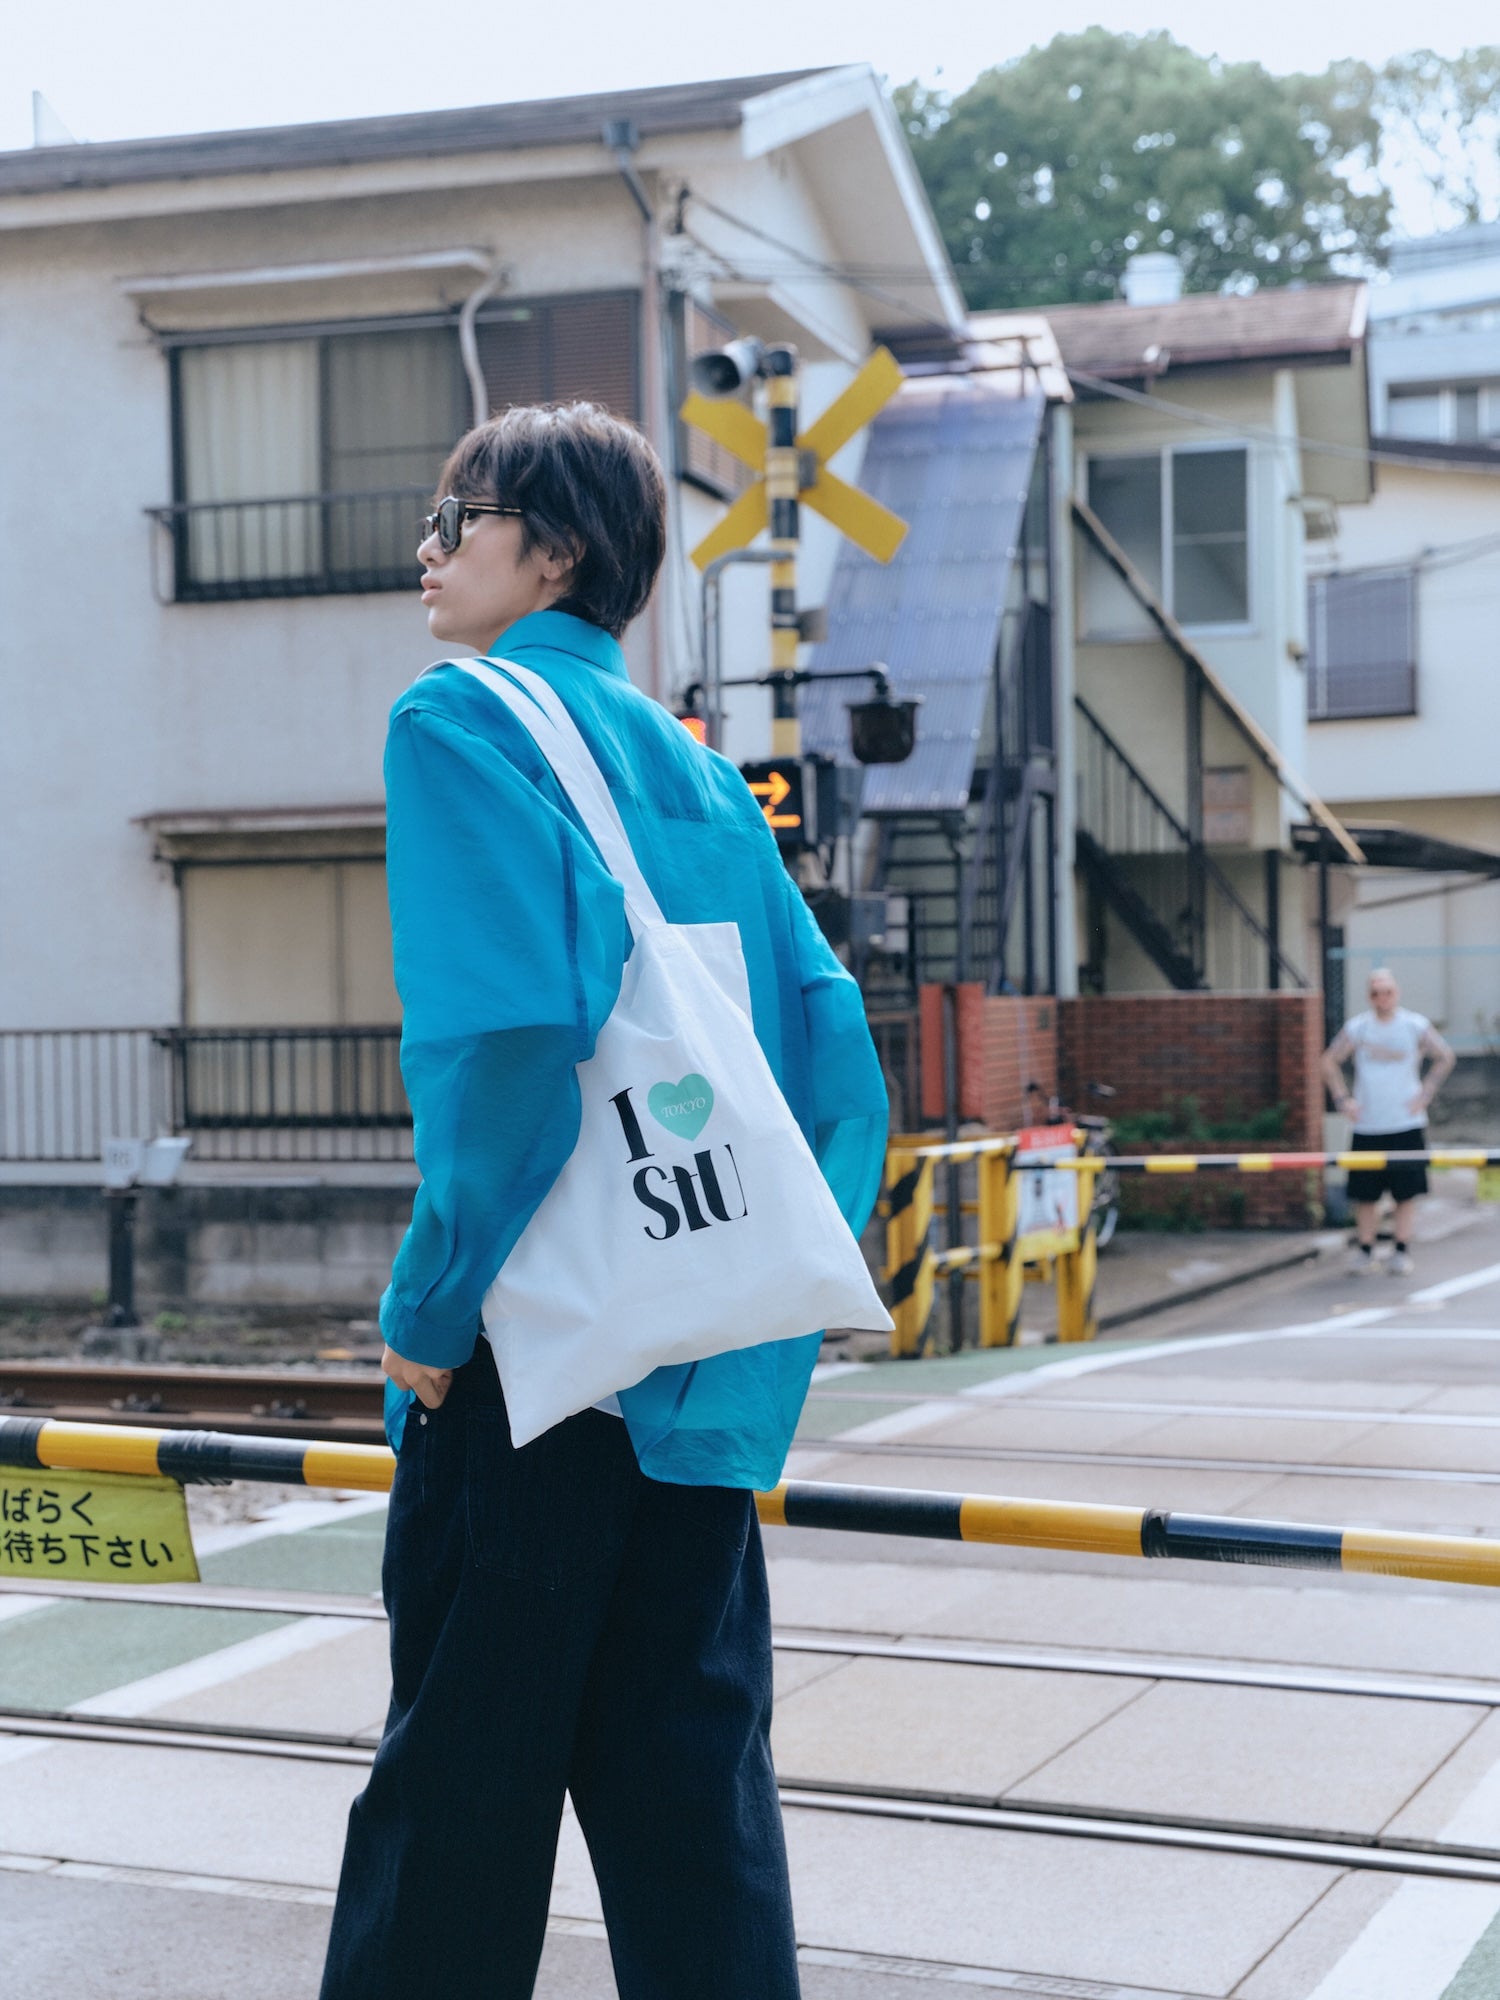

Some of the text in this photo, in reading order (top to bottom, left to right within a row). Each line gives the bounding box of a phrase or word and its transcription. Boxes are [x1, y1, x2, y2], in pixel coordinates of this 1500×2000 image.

[608, 1087, 655, 1163] I
[661, 1097, 706, 1118] TOKYO
[2, 1487, 94, 1526] ばらく
[0, 1530, 173, 1568] 待ち下さい
